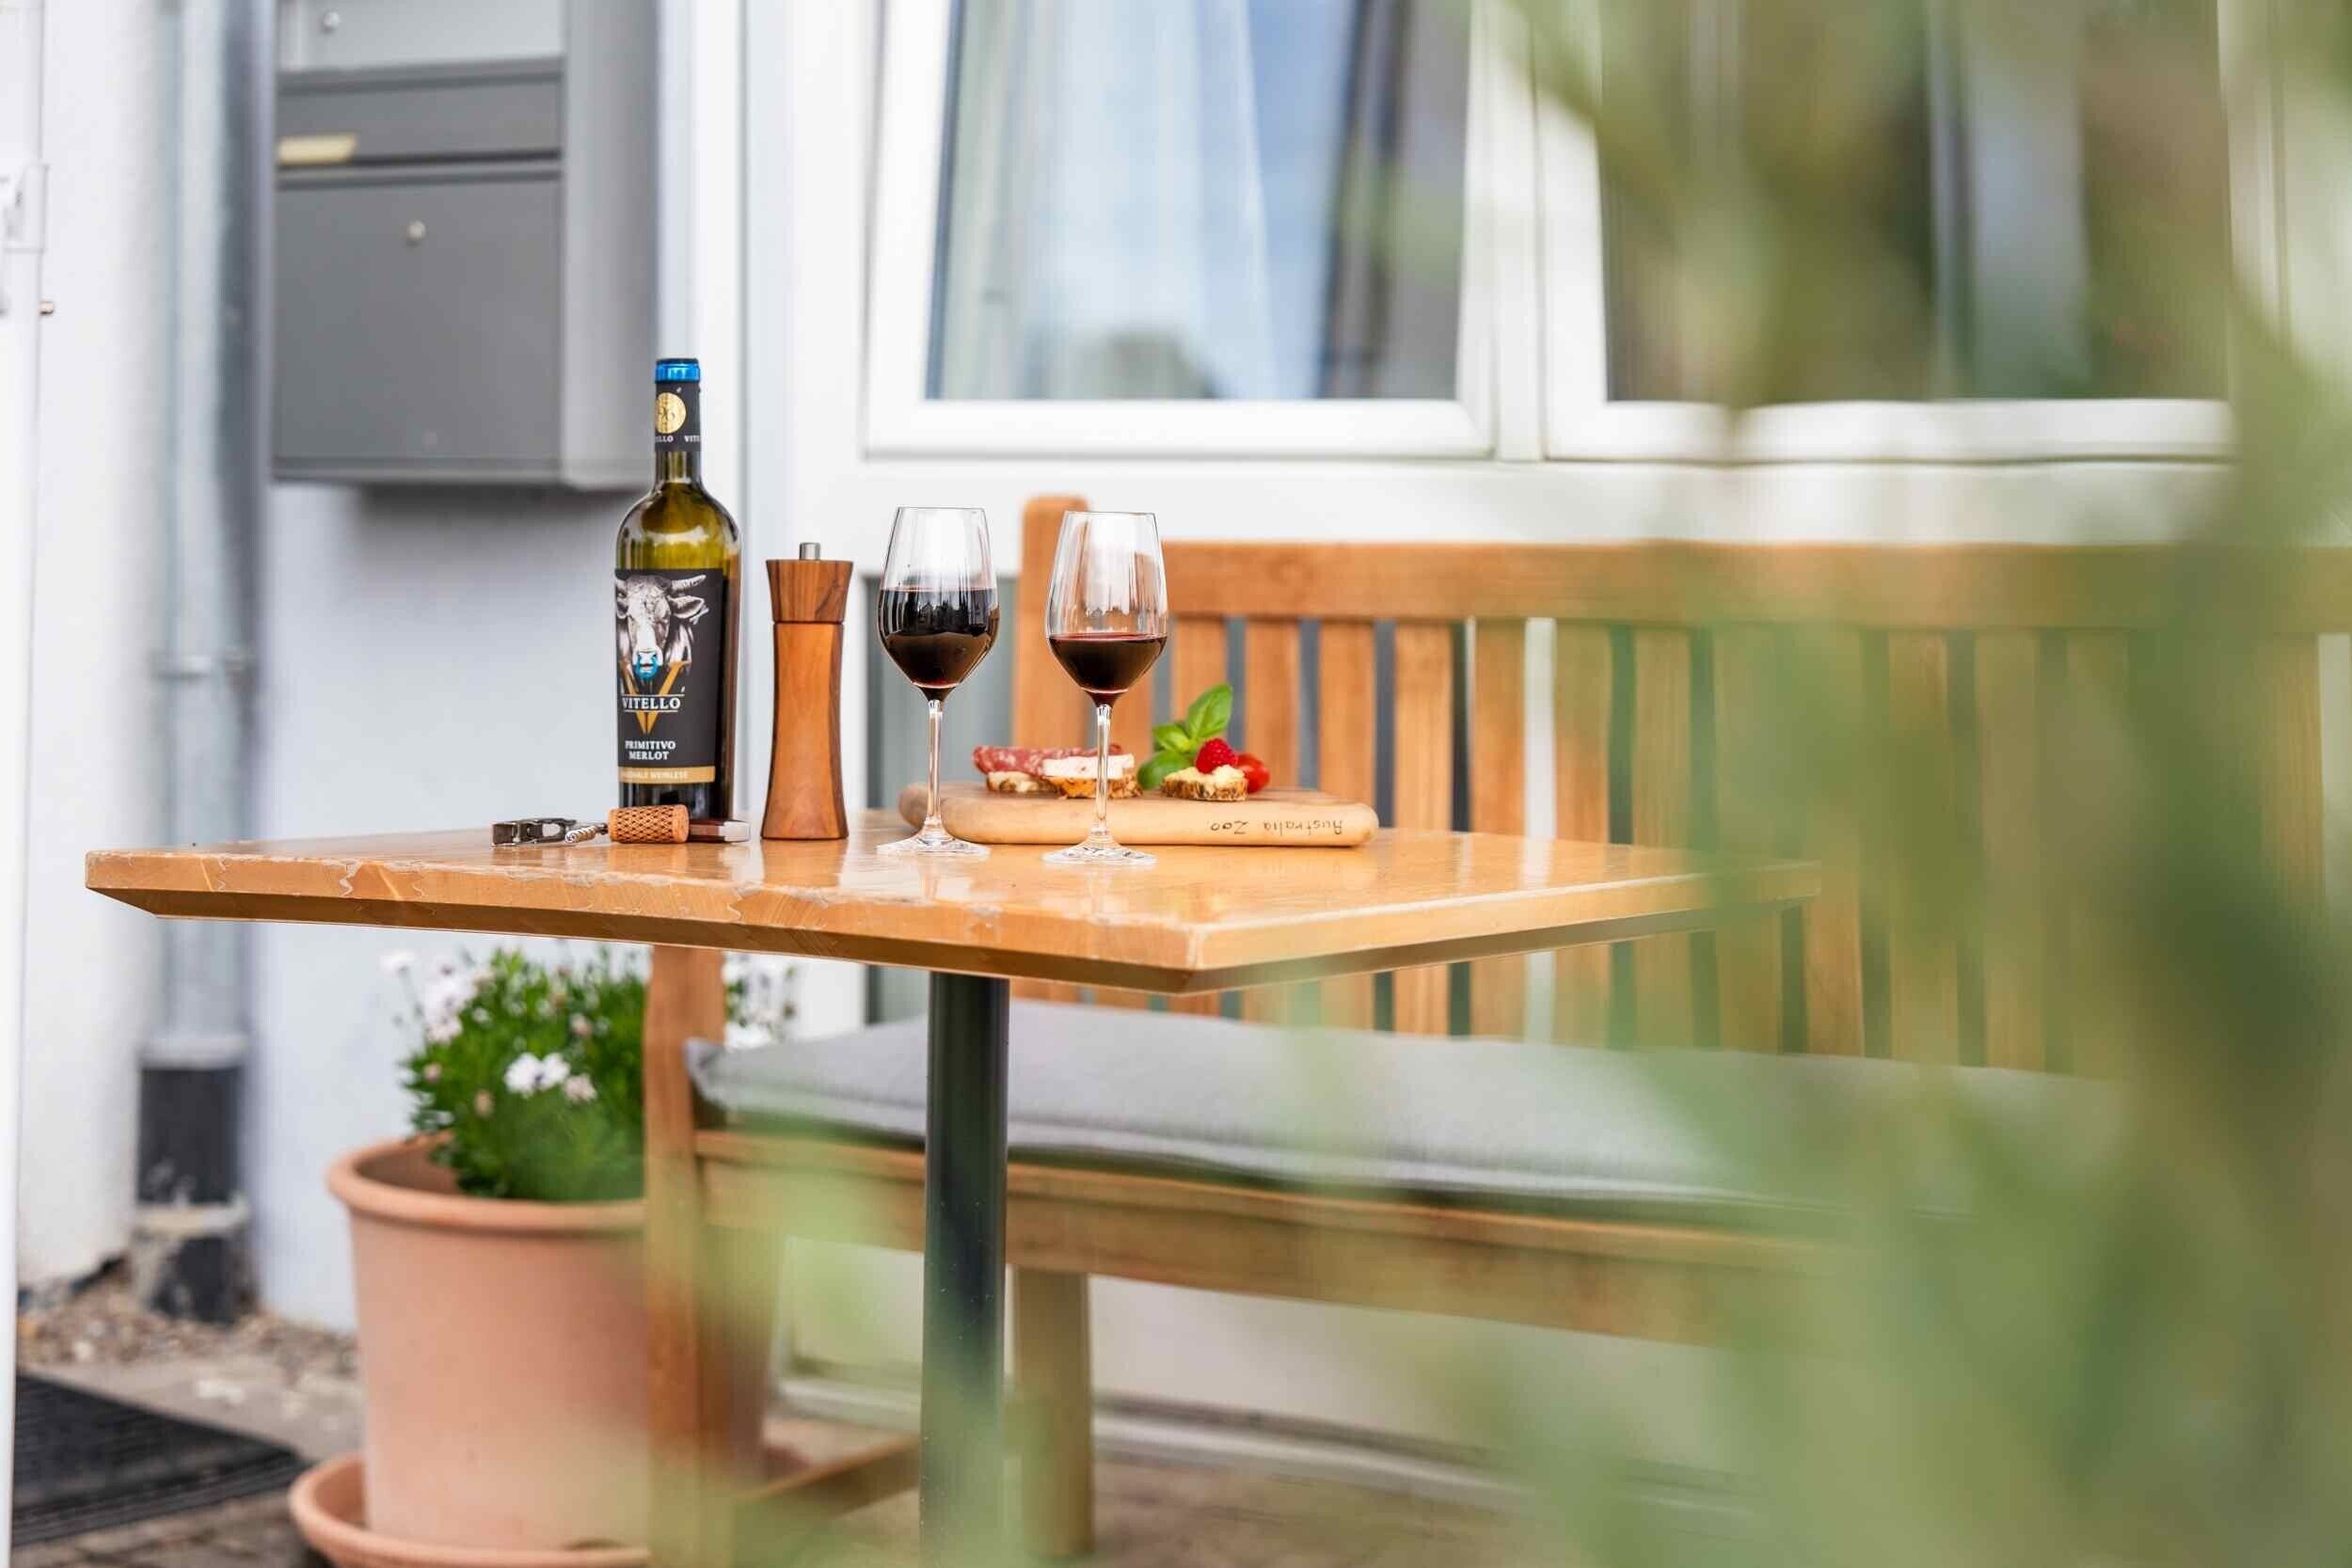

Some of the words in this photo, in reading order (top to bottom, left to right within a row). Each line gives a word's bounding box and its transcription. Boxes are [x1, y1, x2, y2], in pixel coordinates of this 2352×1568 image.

[622, 697, 681, 710] VITELLO
[625, 740, 676, 750] PRIMITIVO
[628, 751, 670, 760] MERLOT
[1210, 820, 1248, 834] Zoo
[1263, 819, 1343, 836] Australia
